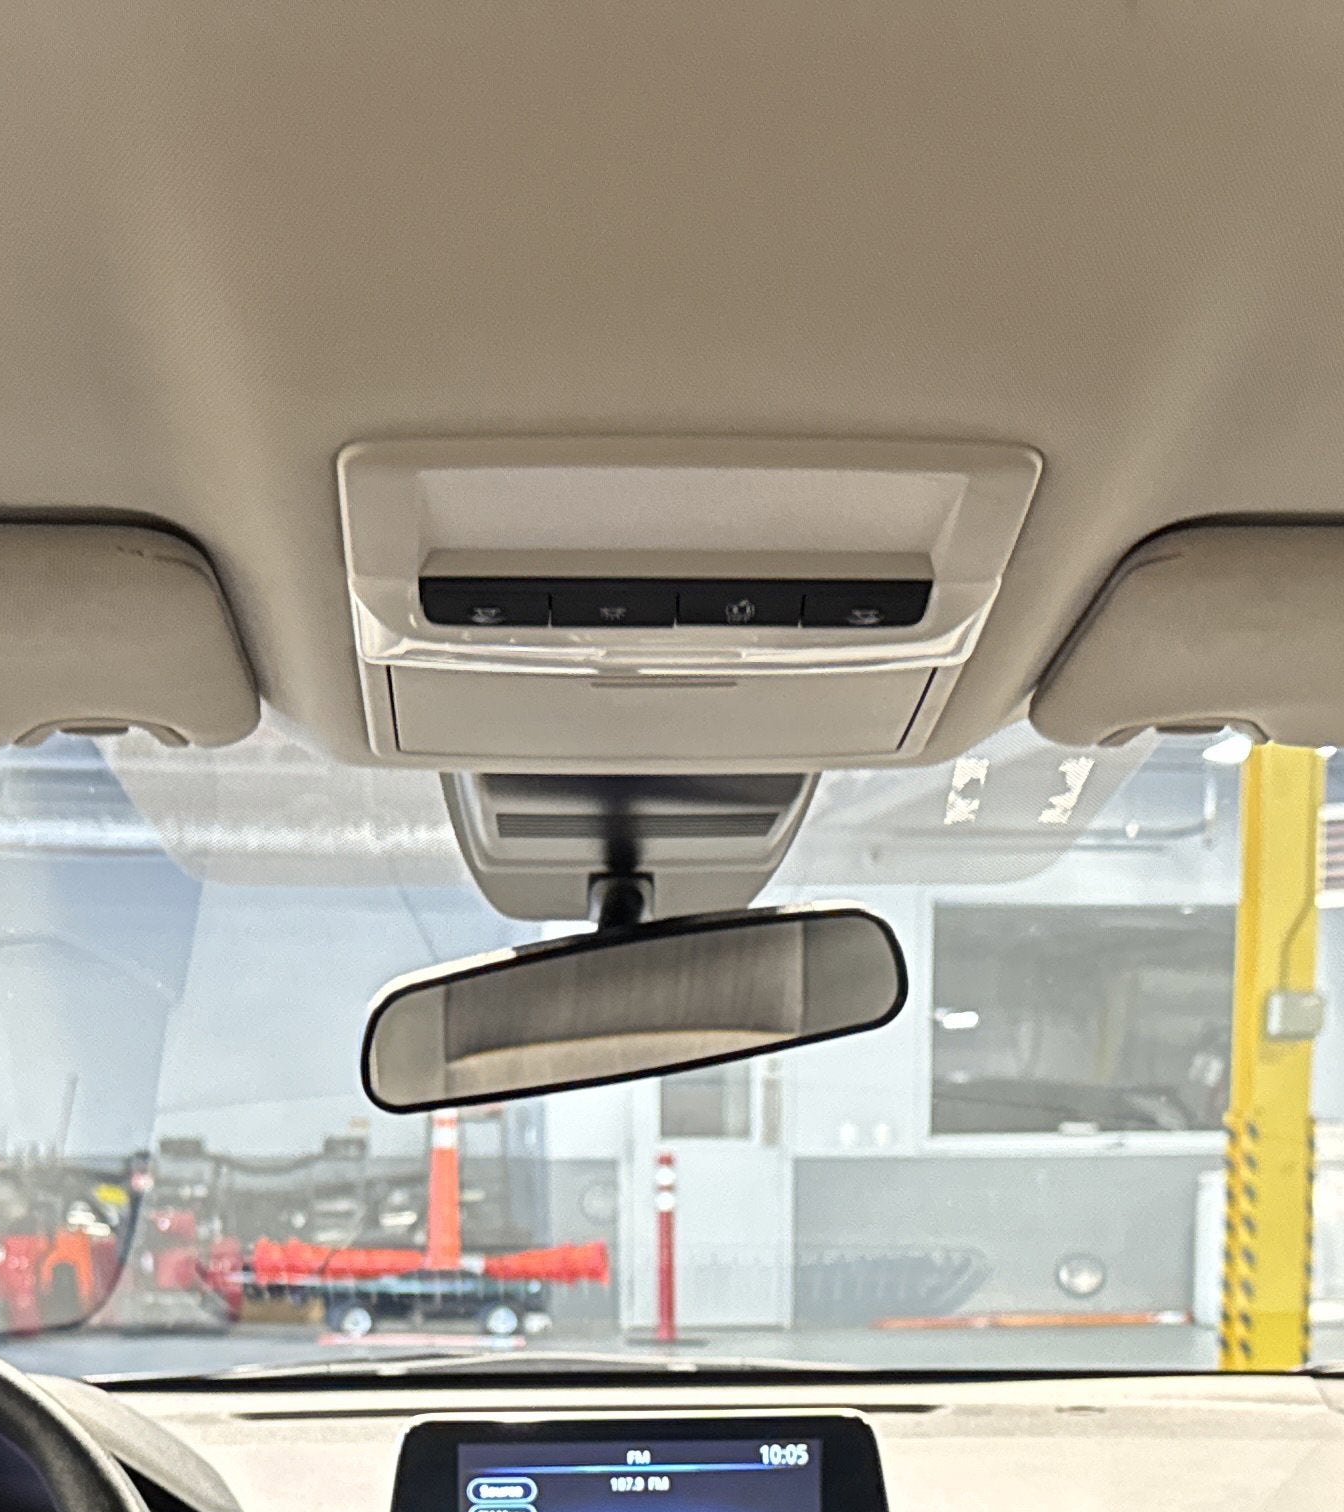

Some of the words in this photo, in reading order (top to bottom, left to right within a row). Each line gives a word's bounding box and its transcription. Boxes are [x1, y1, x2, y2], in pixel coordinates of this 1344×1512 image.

[626, 1450, 651, 1464] FM
[759, 1444, 809, 1465] 10:05
[647, 1476, 670, 1491] FM
